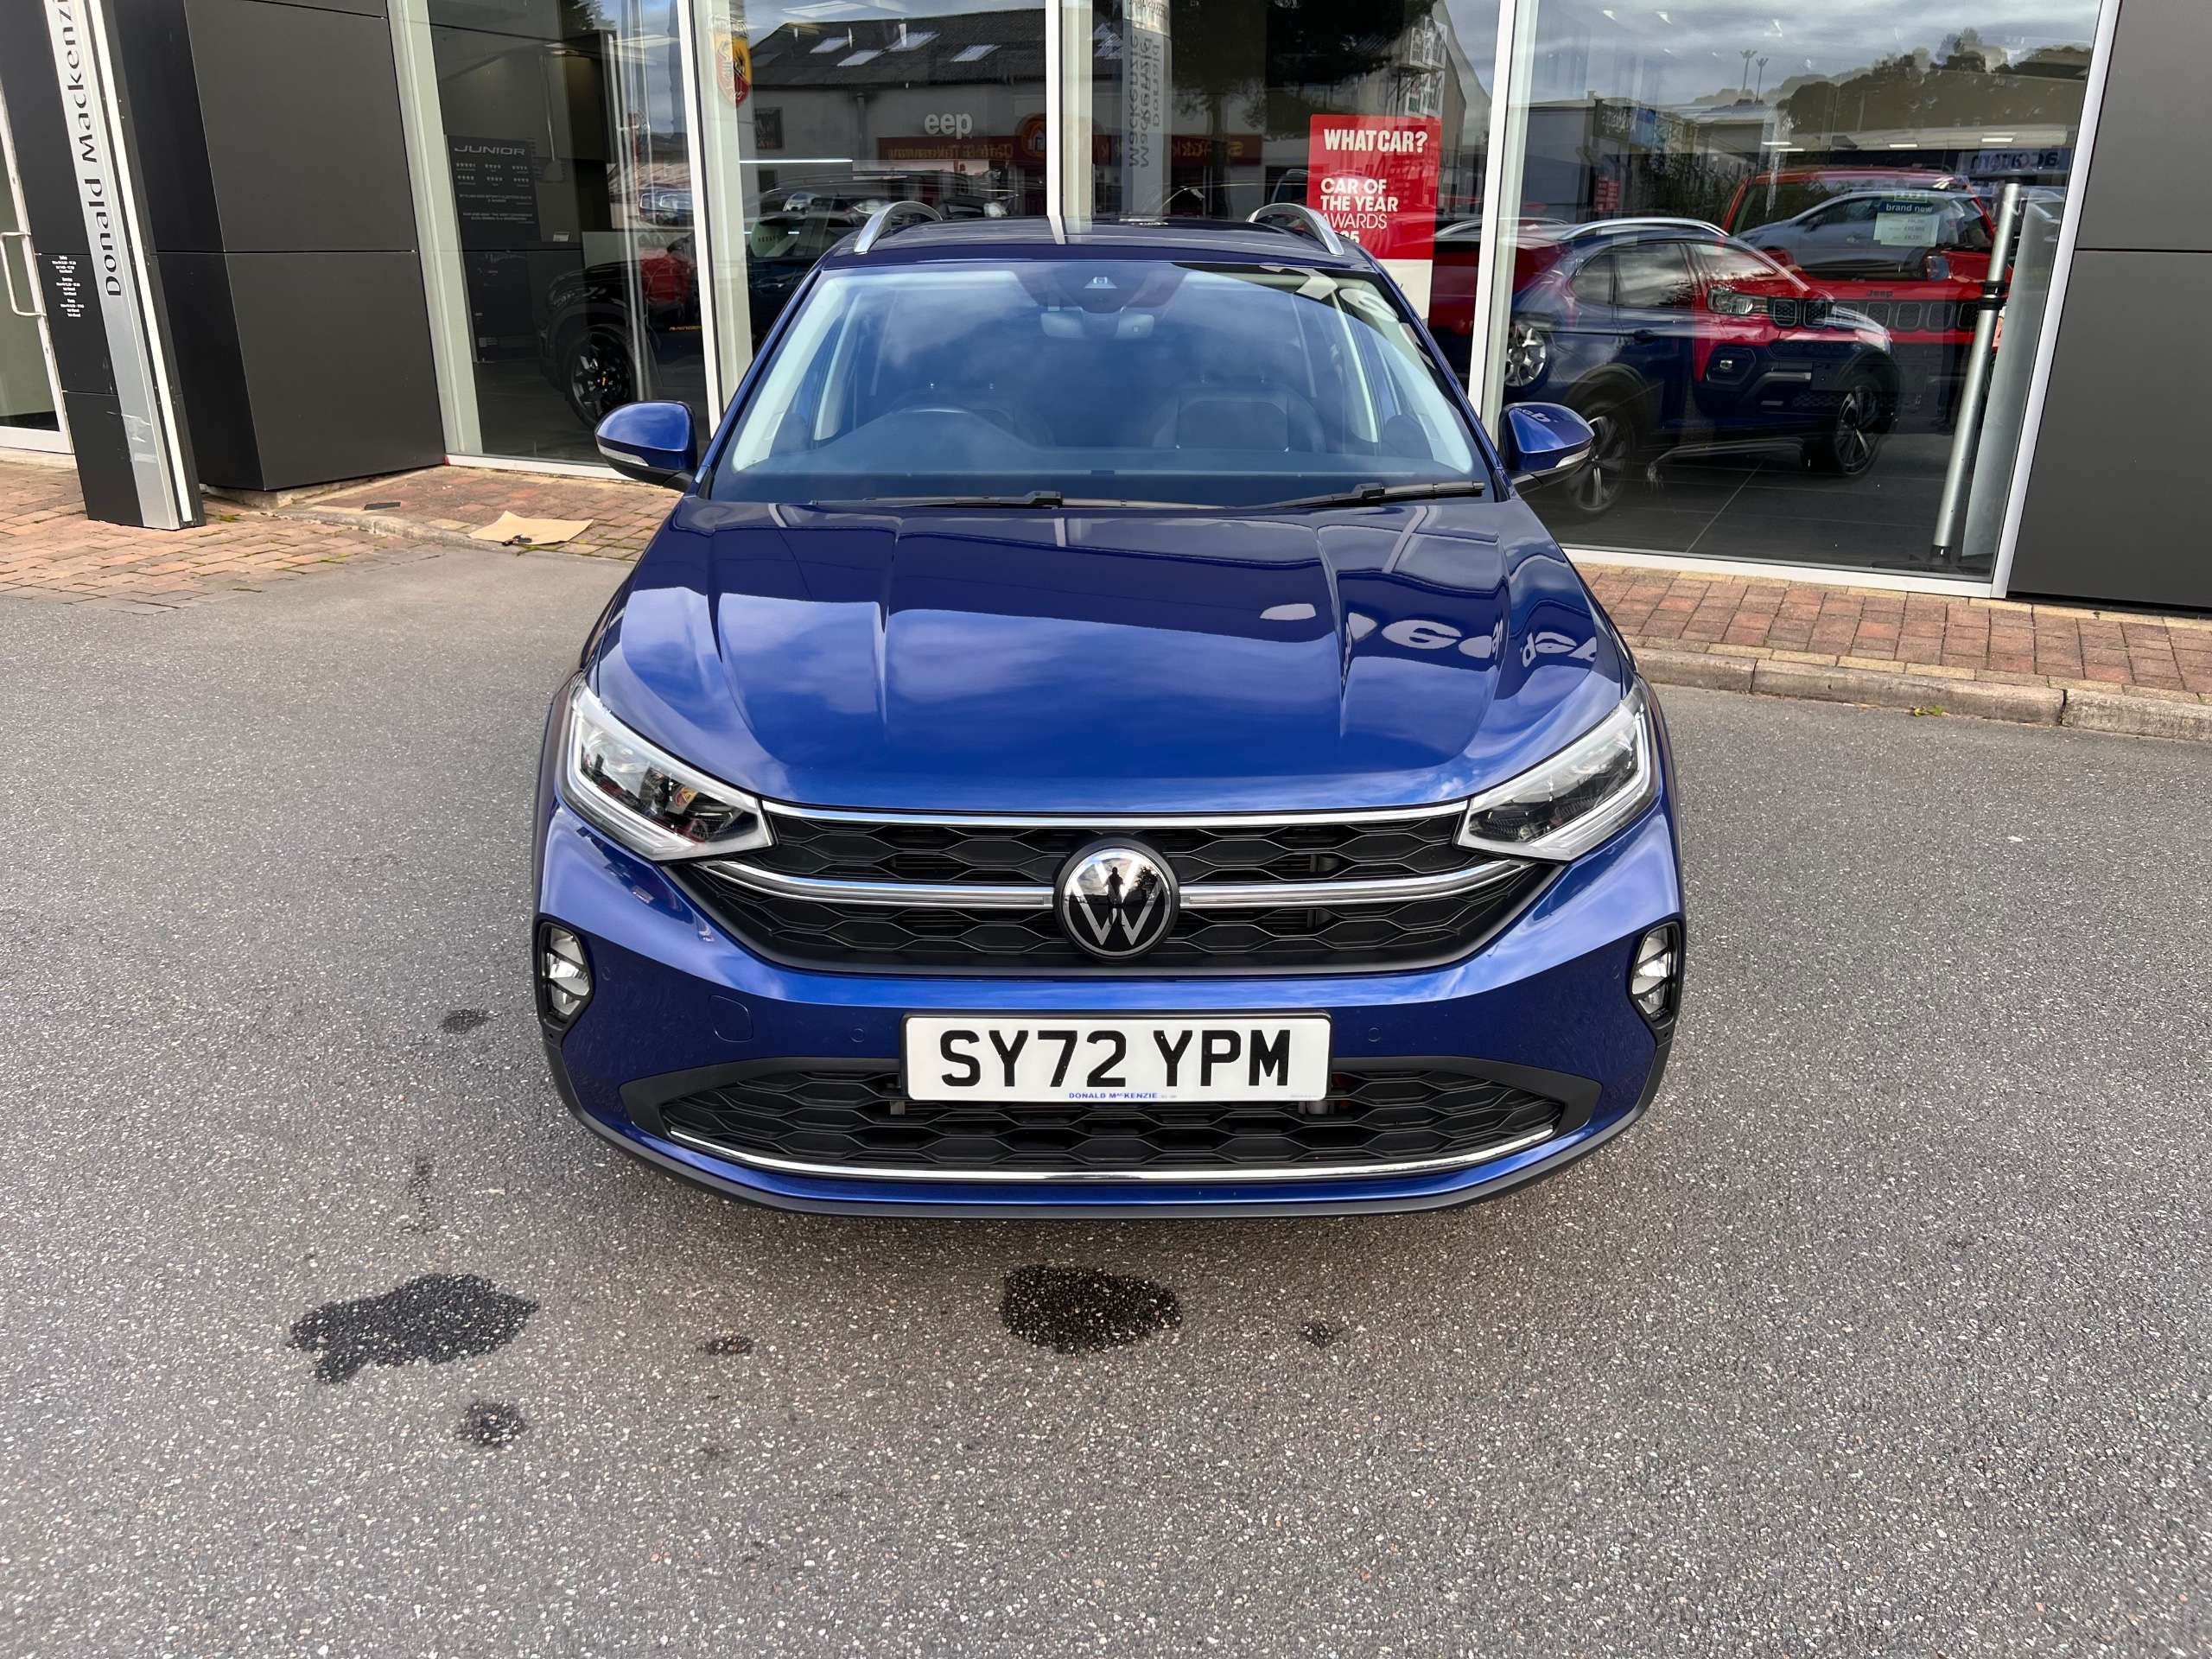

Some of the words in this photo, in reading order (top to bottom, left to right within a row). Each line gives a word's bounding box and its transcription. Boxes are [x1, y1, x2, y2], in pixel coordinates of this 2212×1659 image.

[454, 145, 525, 156] JUNIOR
[1320, 178, 1358, 194] CAR
[1363, 179, 1387, 194] OF
[1320, 195, 1350, 212] THE
[1355, 196, 1399, 212] YEAR
[84, 178, 122, 296] Donald
[940, 1029, 1126, 1088] SY72
[1154, 1029, 1291, 1088] YPM
